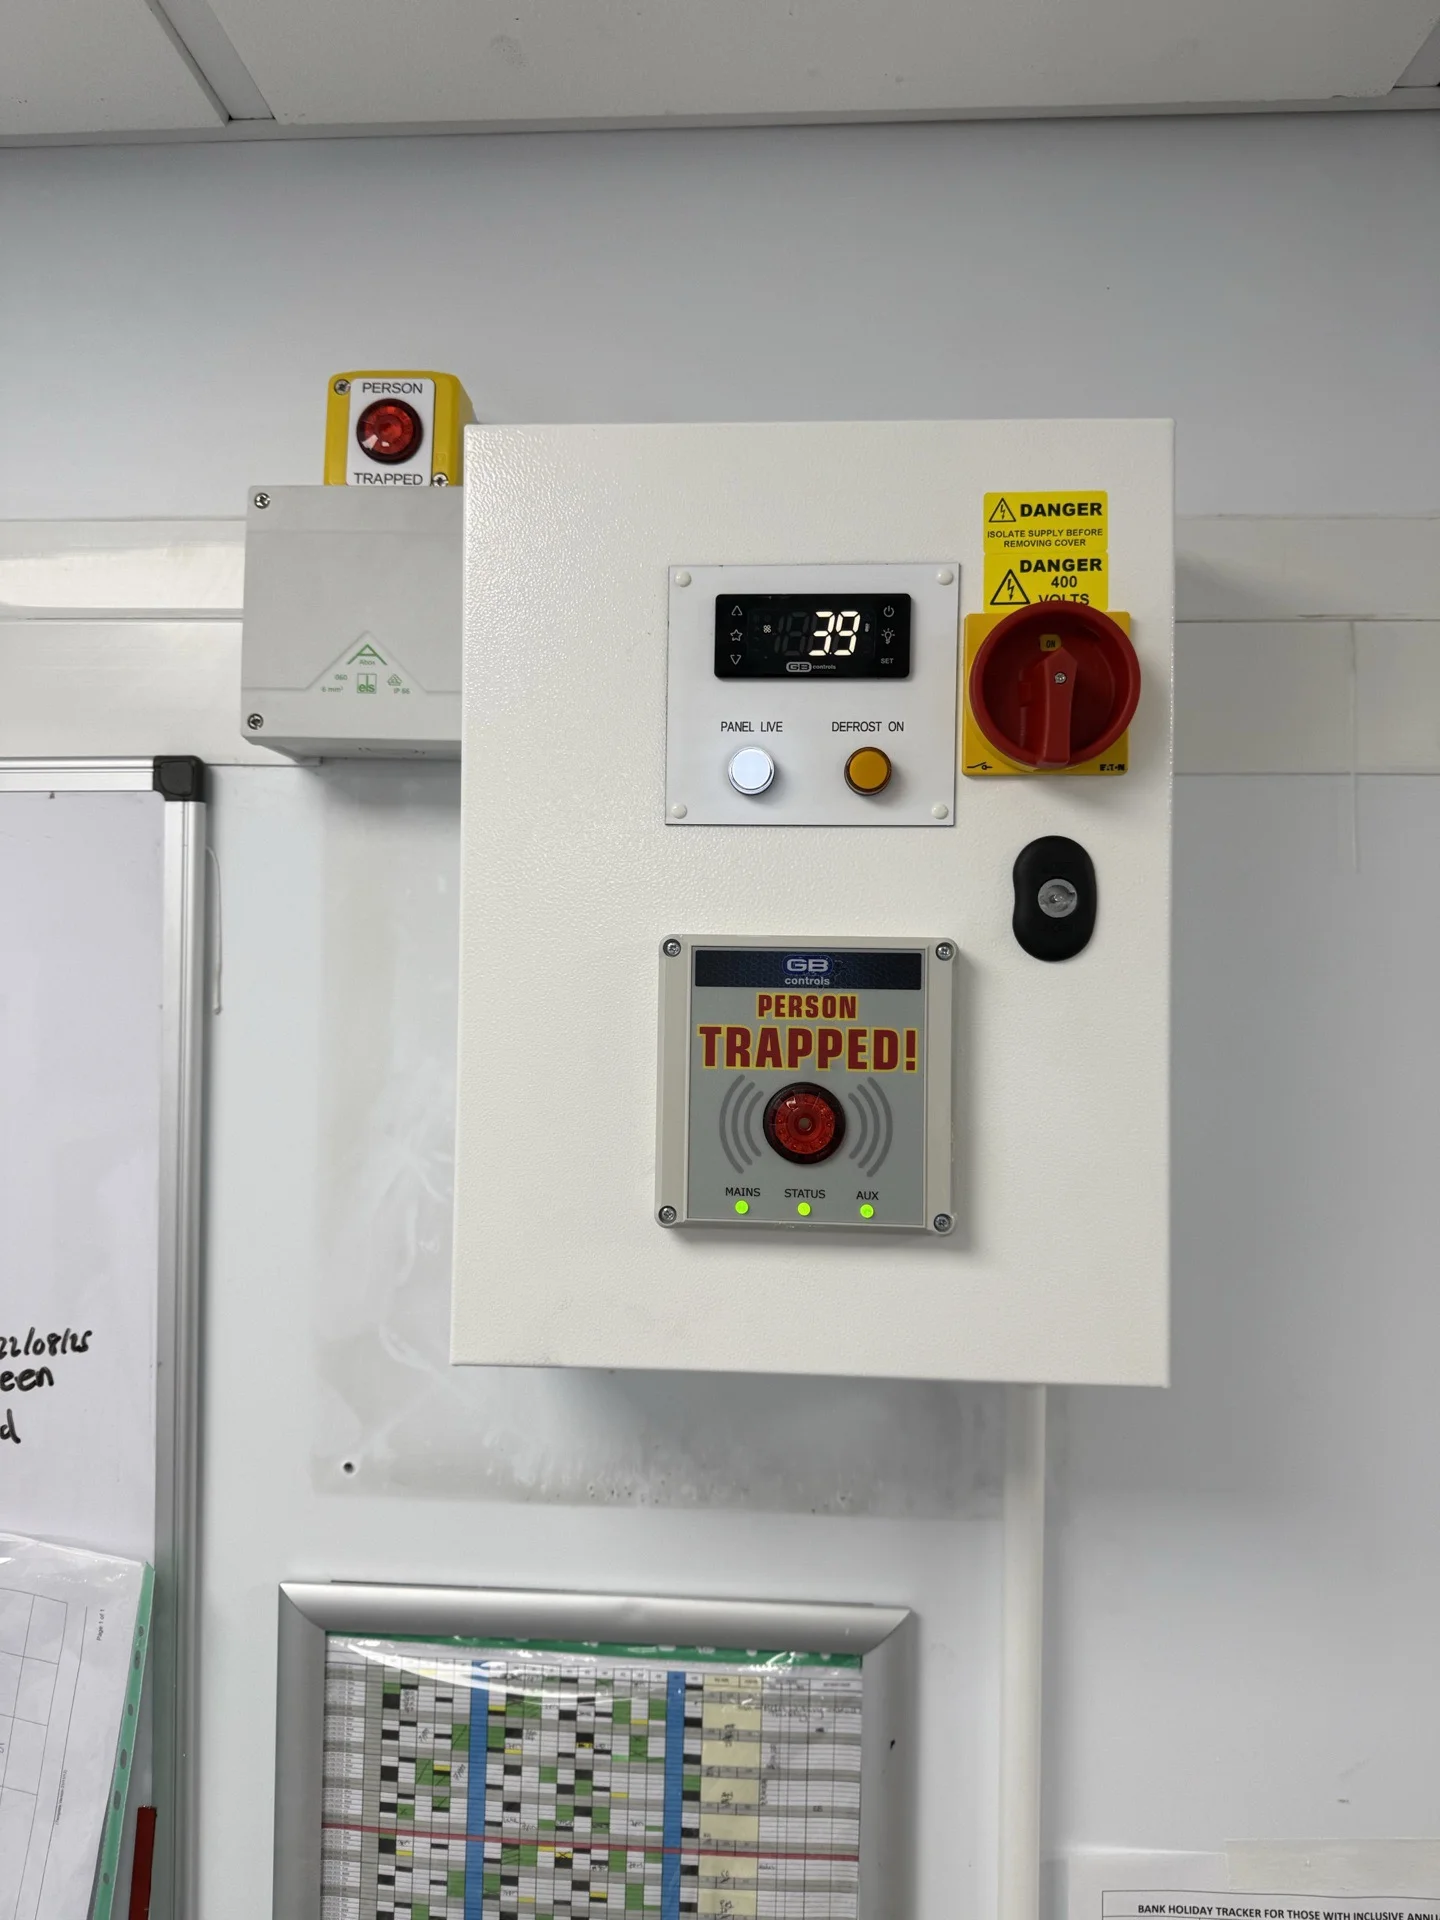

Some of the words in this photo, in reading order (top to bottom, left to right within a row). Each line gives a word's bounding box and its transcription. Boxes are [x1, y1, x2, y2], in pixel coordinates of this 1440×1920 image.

[362, 382, 423, 395] PERSON
[354, 472, 423, 486] TRAPPED
[1019, 502, 1103, 518] DANGER
[987, 530, 1025, 539] ISOLATE
[1028, 529, 1064, 538] SUPPLY
[1066, 528, 1103, 537] BEFORE
[1003, 539, 1052, 548] REMOVING
[1054, 538, 1086, 547] COVER
[1019, 558, 1103, 573] DANGER
[1050, 575, 1078, 588] 400
[1045, 639, 1056, 649] ON
[720, 721, 755, 732] PANEL
[760, 721, 784, 732] LIVE
[831, 721, 882, 732] DEFROST
[888, 721, 905, 732] ON
[786, 958, 829, 973] GB
[784, 976, 830, 986] controls
[757, 993, 858, 1020] PERSON
[697, 1024, 918, 1073] TRAPPED!
[725, 1187, 761, 1197] MAINS
[784, 1188, 826, 1199] STATUS
[856, 1190, 879, 1200] AUX
[96, 1625, 104, 1641] Page
[1137, 1904, 1166, 1914] BANK
[1168, 1905, 1213, 1916] HOLIDAY
[1215, 1907, 1262, 1918] TRACKER
[1264, 1908, 1285, 1919] FOR
[1286, 1909, 1320, 1920] THOSE
[1322, 1911, 1351, 1920] WITH
[1353, 1911, 1404, 1920] INCLUSIVE
